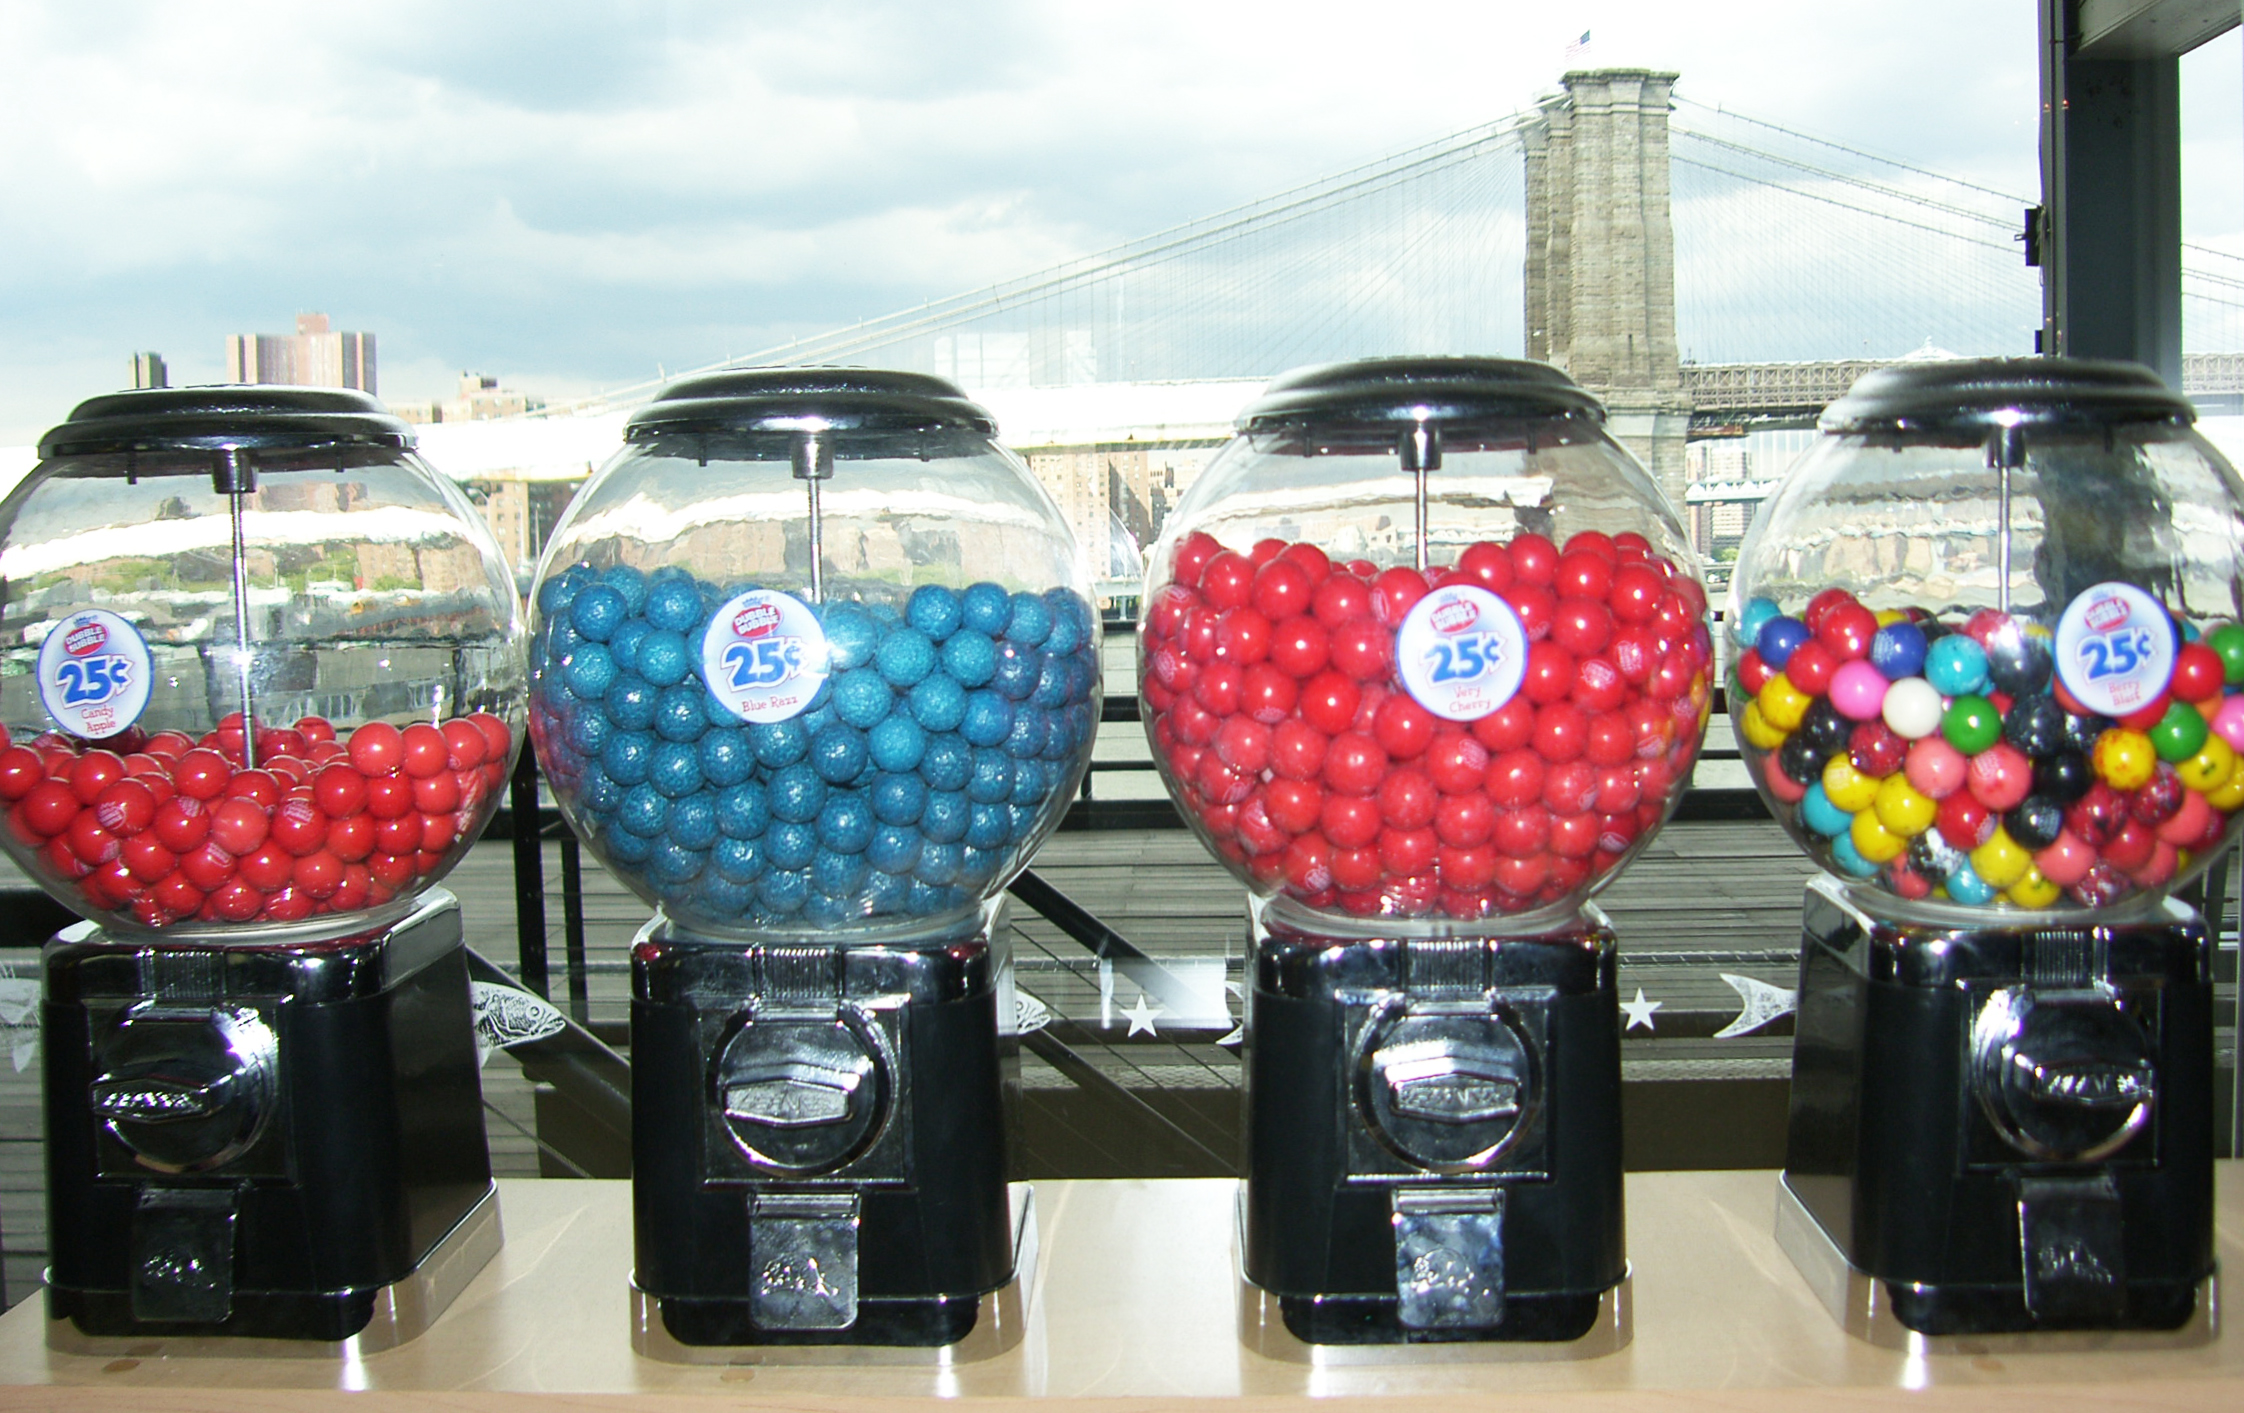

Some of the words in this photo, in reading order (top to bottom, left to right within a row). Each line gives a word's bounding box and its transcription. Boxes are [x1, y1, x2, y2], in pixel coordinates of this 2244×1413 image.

[735, 606, 777, 626] DUBBLE
[738, 614, 780, 635] BUBBLE
[66, 626, 103, 645] DUBBLE
[69, 634, 105, 653] BUBBLE
[723, 639, 803, 689] 25¢
[1422, 634, 1502, 685] 25¢
[2079, 631, 2153, 682] 25¢
[56, 657, 130, 705] 25¢
[1454, 685, 1481, 699] Very
[81, 705, 114, 719] Candy
[742, 699, 767, 713] Blue
[769, 695, 799, 709] Razz
[1448, 698, 1491, 713] Cherry
[86, 719, 116, 735] Apple
